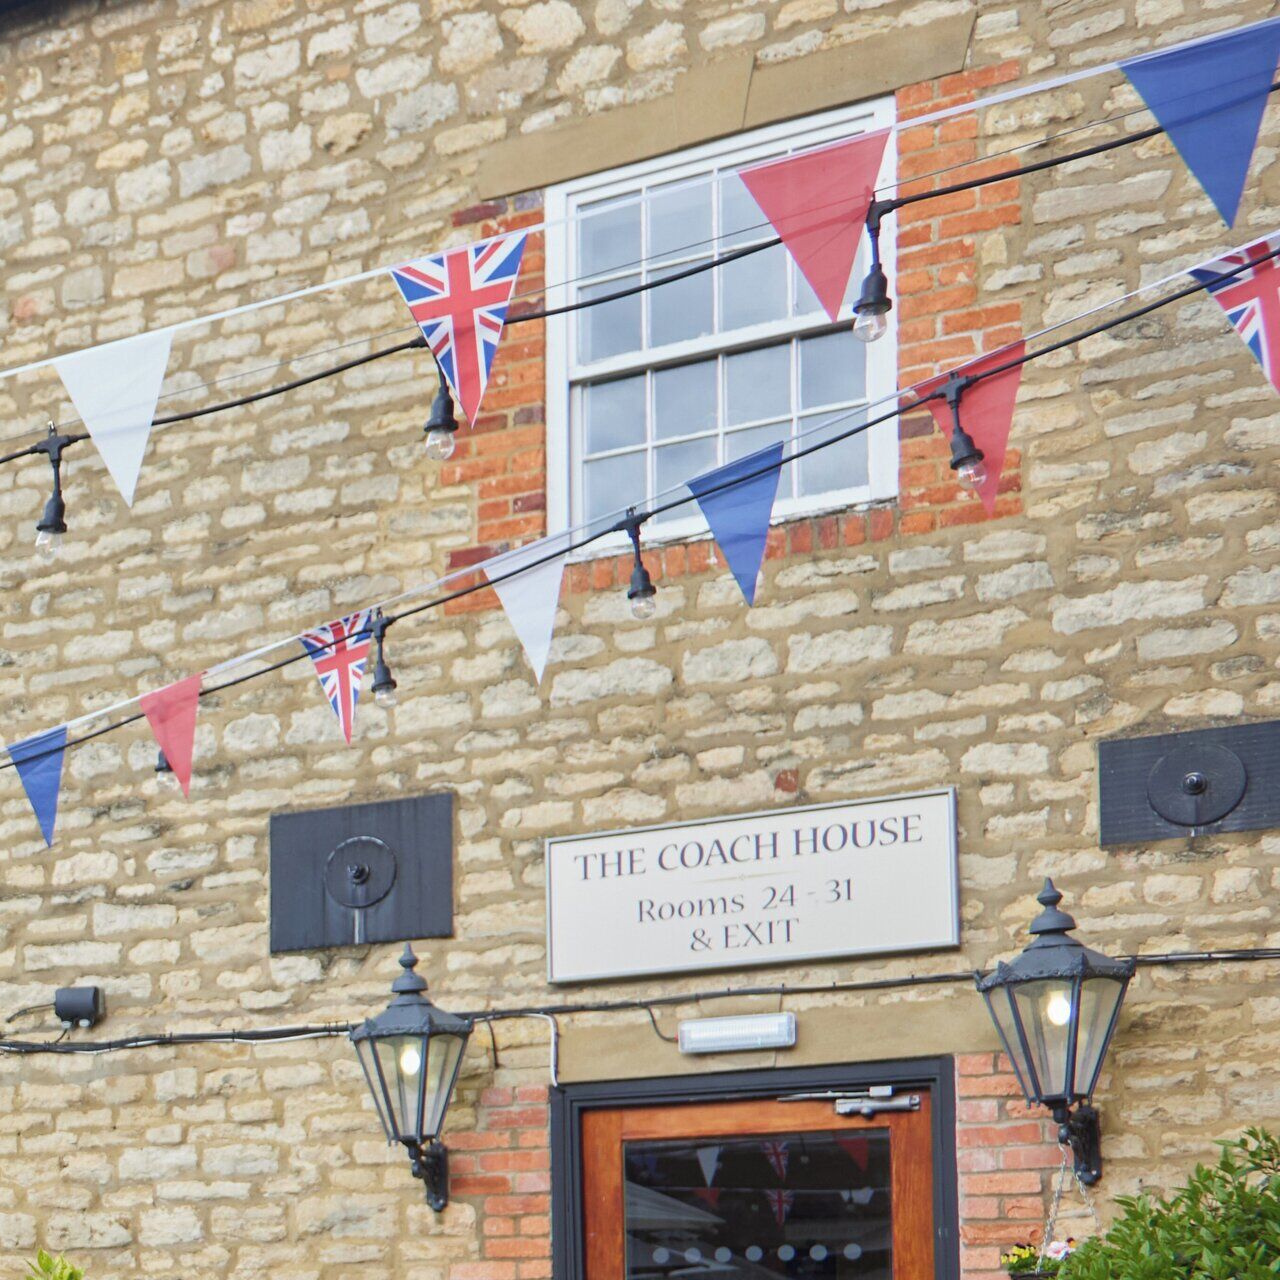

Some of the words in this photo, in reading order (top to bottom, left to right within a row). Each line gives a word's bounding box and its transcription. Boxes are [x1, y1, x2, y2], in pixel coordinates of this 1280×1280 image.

[574, 845, 647, 881] THE
[657, 831, 780, 871] COACH
[793, 814, 924, 856] HOUSE
[637, 893, 746, 924] Rooms
[761, 881, 797, 911] 24
[824, 877, 854, 903] 31
[690, 926, 713, 953] &
[723, 918, 801, 950] EXIT
